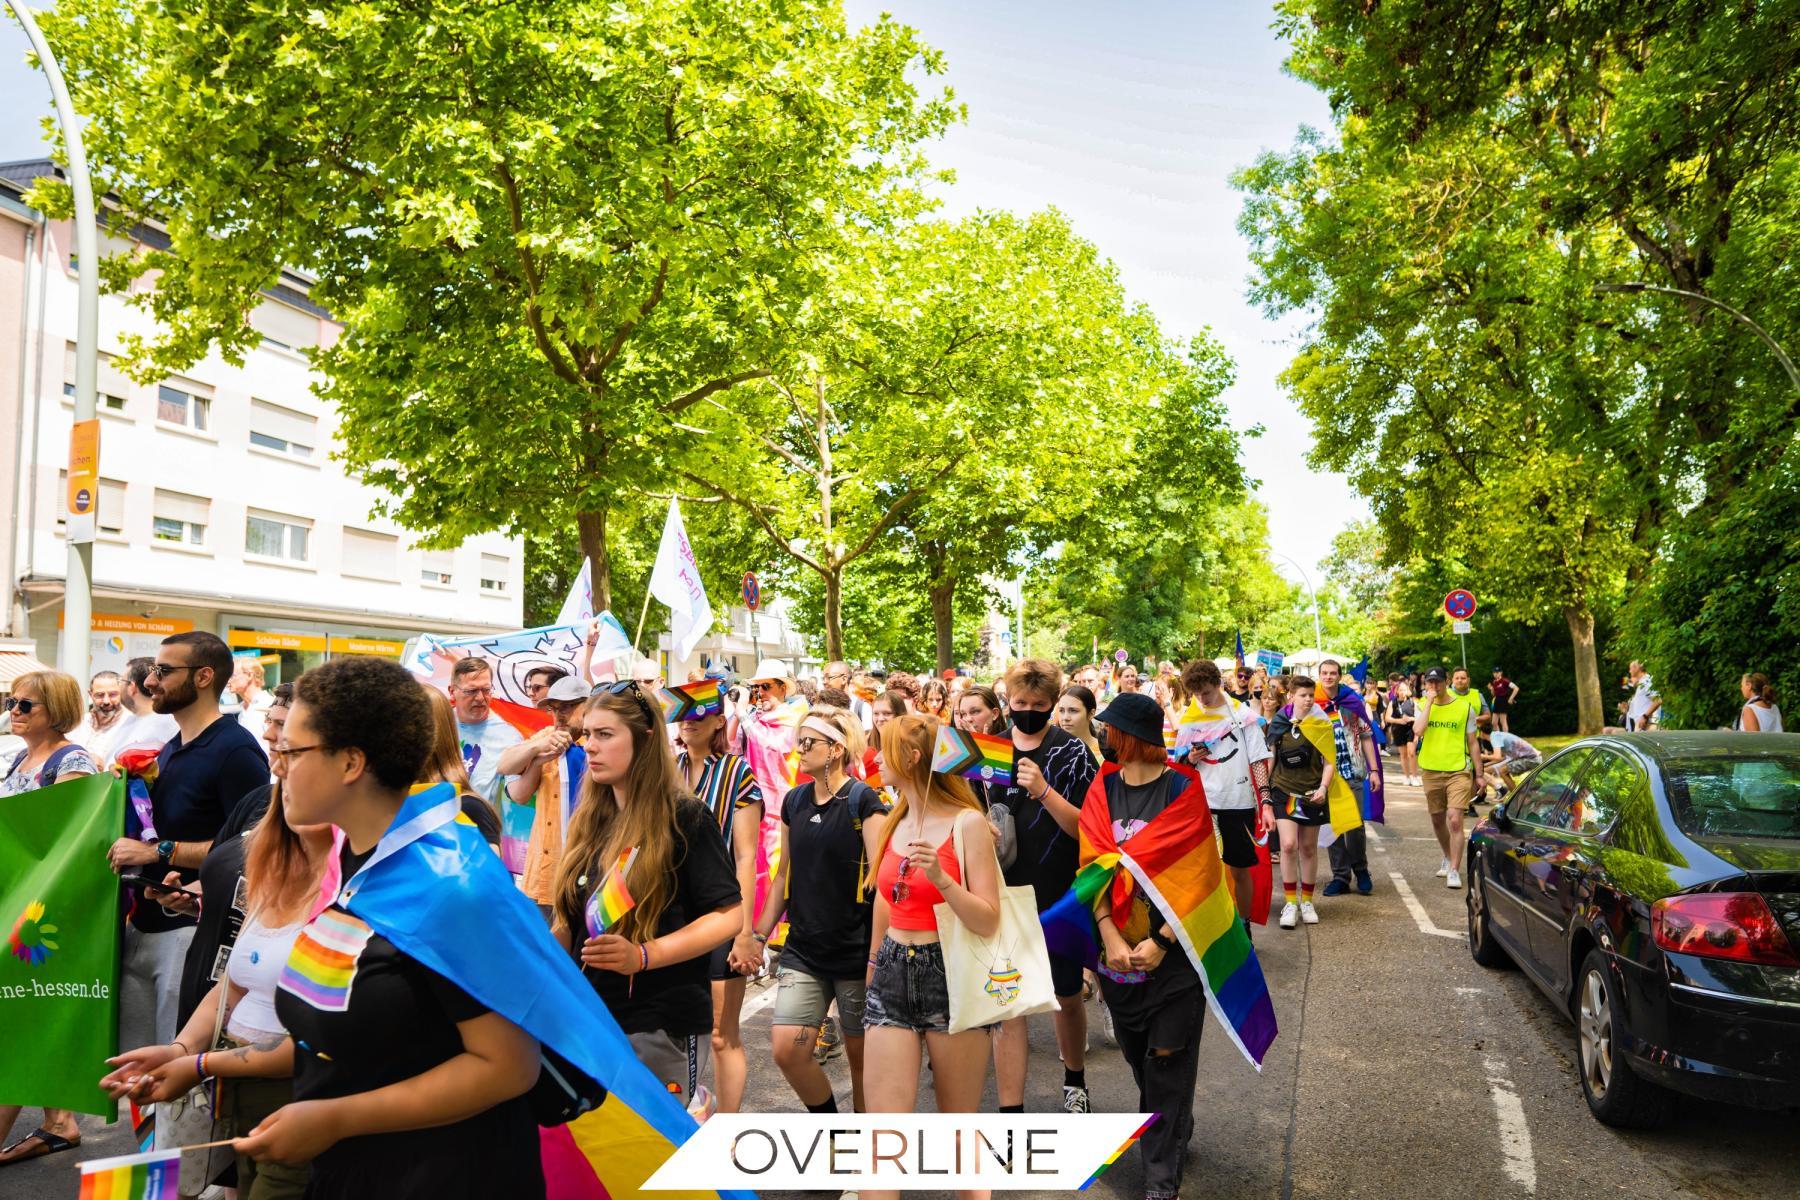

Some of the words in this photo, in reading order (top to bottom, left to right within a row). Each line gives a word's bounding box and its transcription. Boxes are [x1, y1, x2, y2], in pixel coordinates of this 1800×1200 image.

[105, 620, 132, 629] HEIZUNG
[133, 622, 147, 630] VON
[256, 636, 280, 646] Schöne
